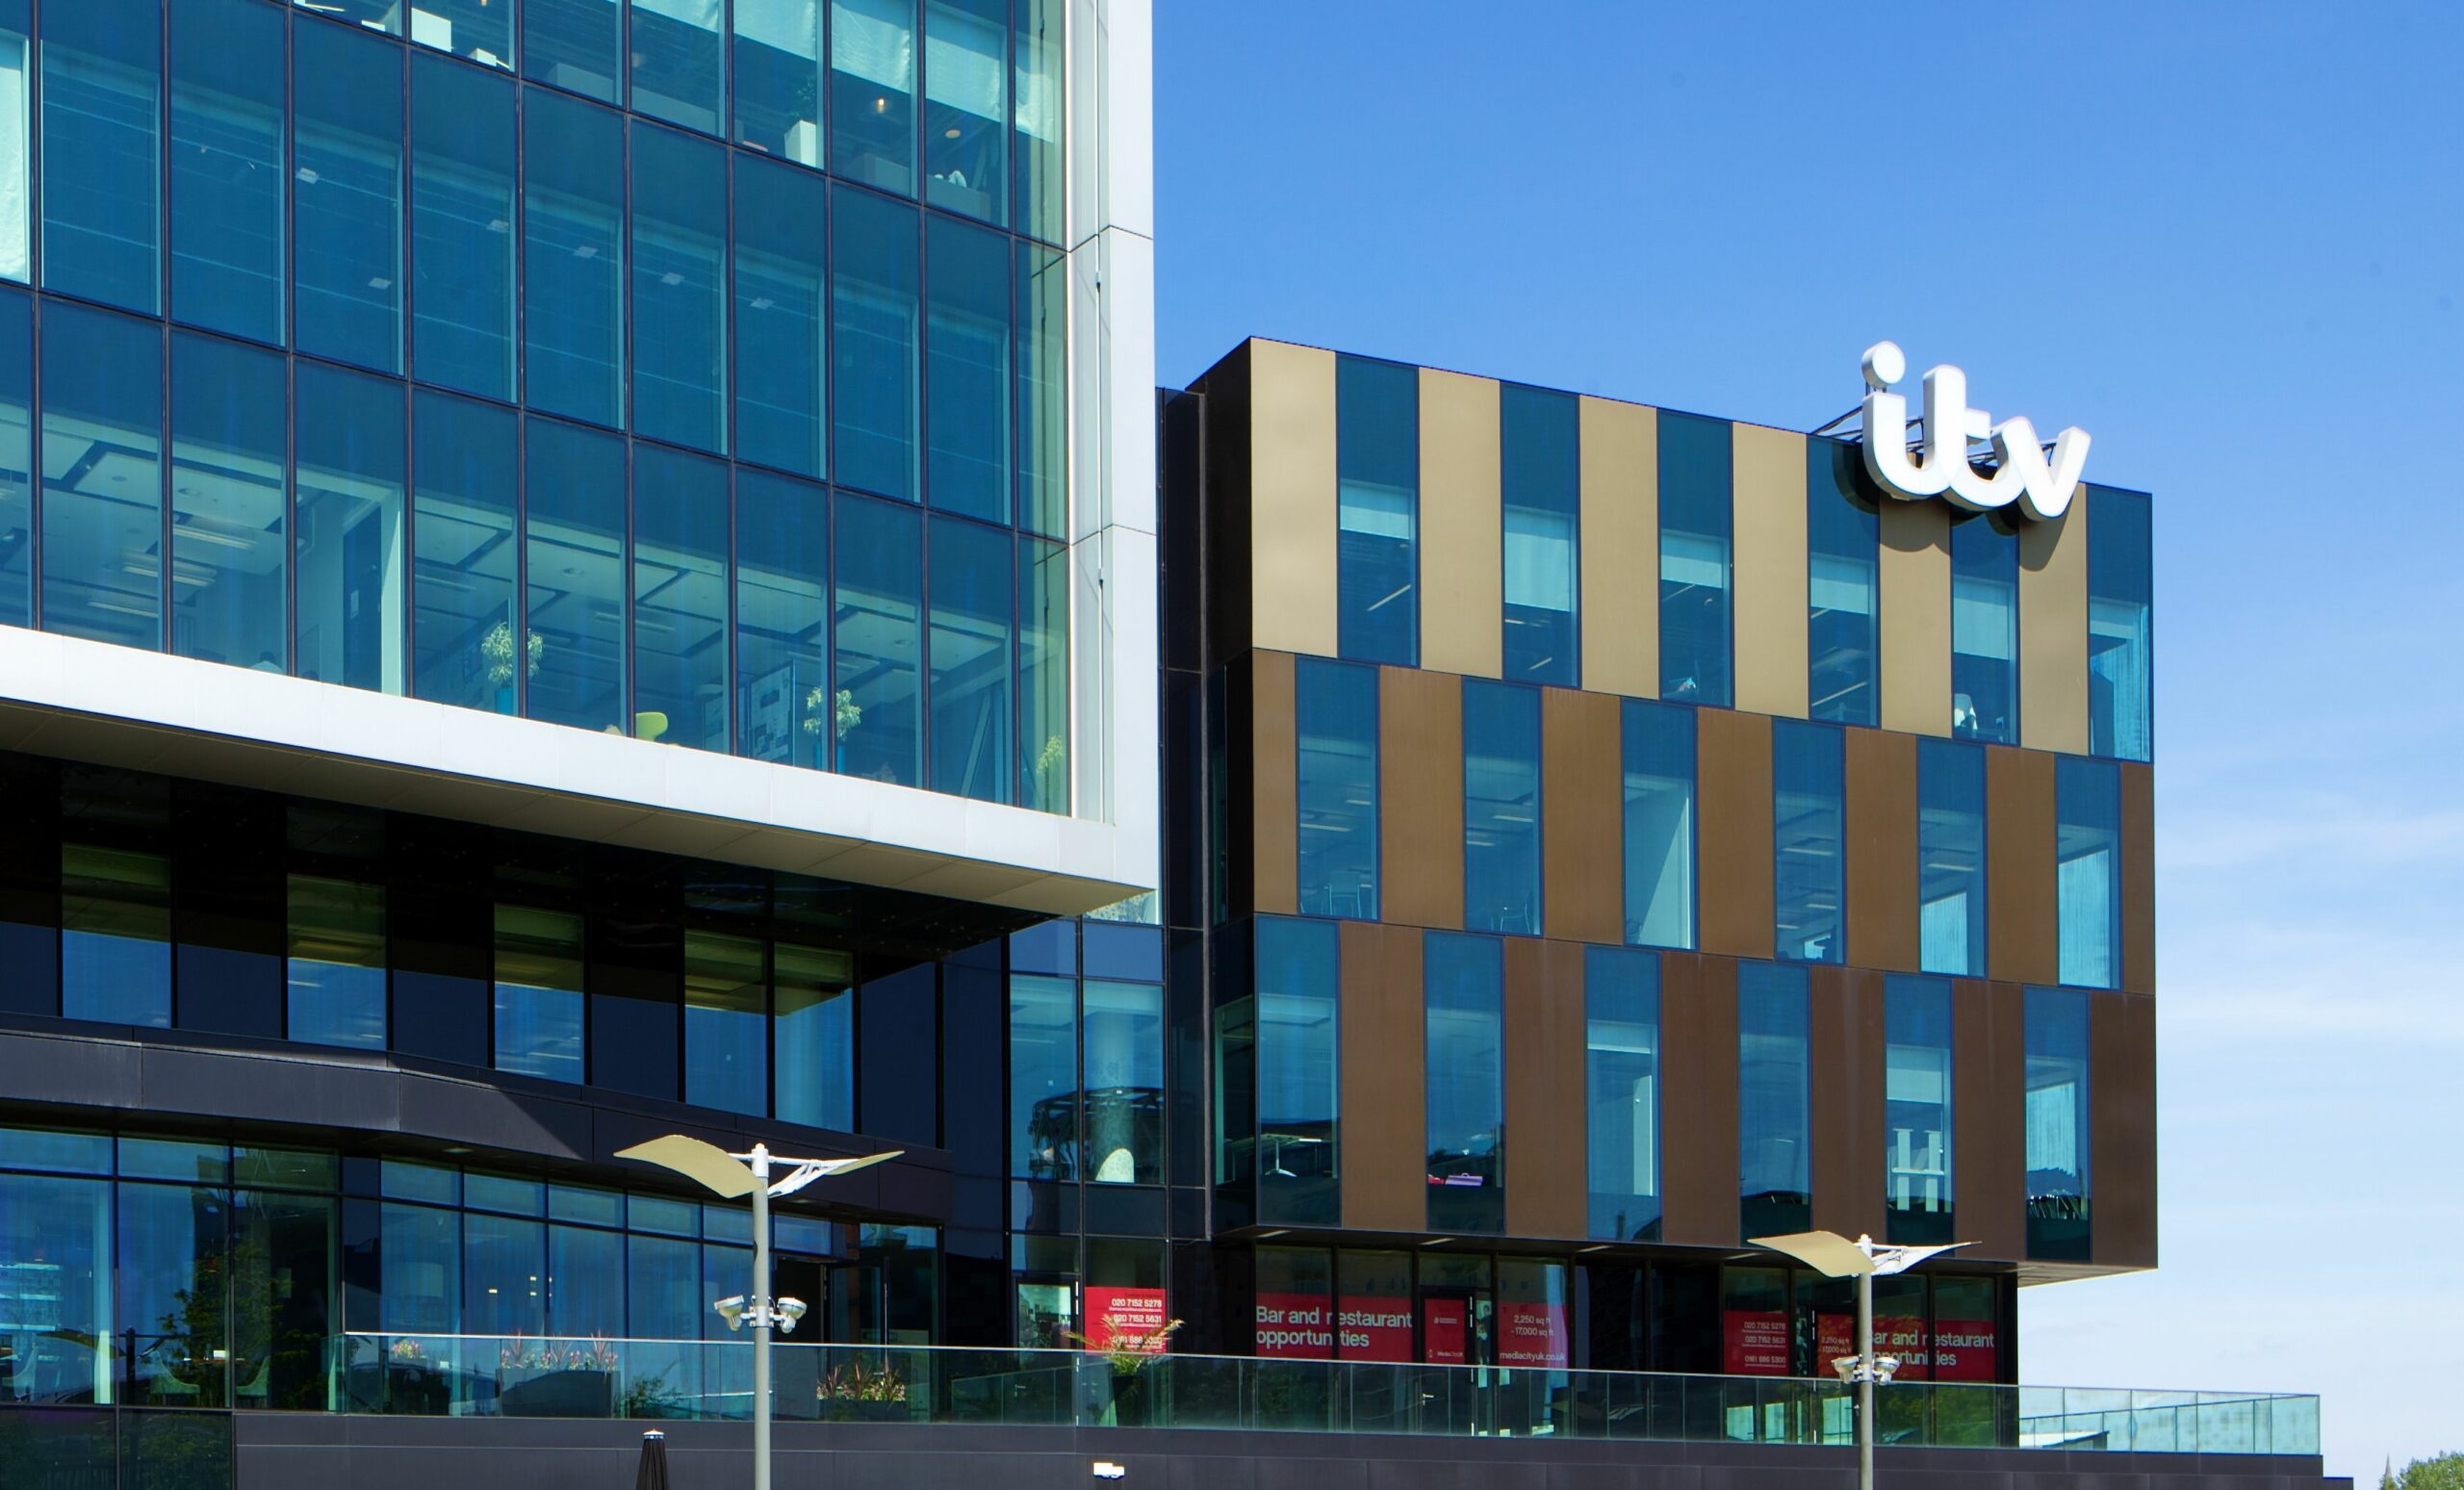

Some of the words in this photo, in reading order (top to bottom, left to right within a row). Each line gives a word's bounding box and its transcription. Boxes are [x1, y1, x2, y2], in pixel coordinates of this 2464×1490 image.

[1861, 340, 2092, 522] itv
[1112, 1298, 1125, 1307] 020
[1127, 1298, 1142, 1307] 7152
[1256, 1305, 1285, 1324] Bar
[1289, 1306, 1320, 1325] and
[1326, 1310, 1413, 1328] restaurant
[1256, 1329, 1370, 1349] opportunties
[1872, 1330, 1887, 1345] ar
[1892, 1329, 1918, 1346] and
[1500, 1350, 1566, 1363] mediacityuk.co.uk
